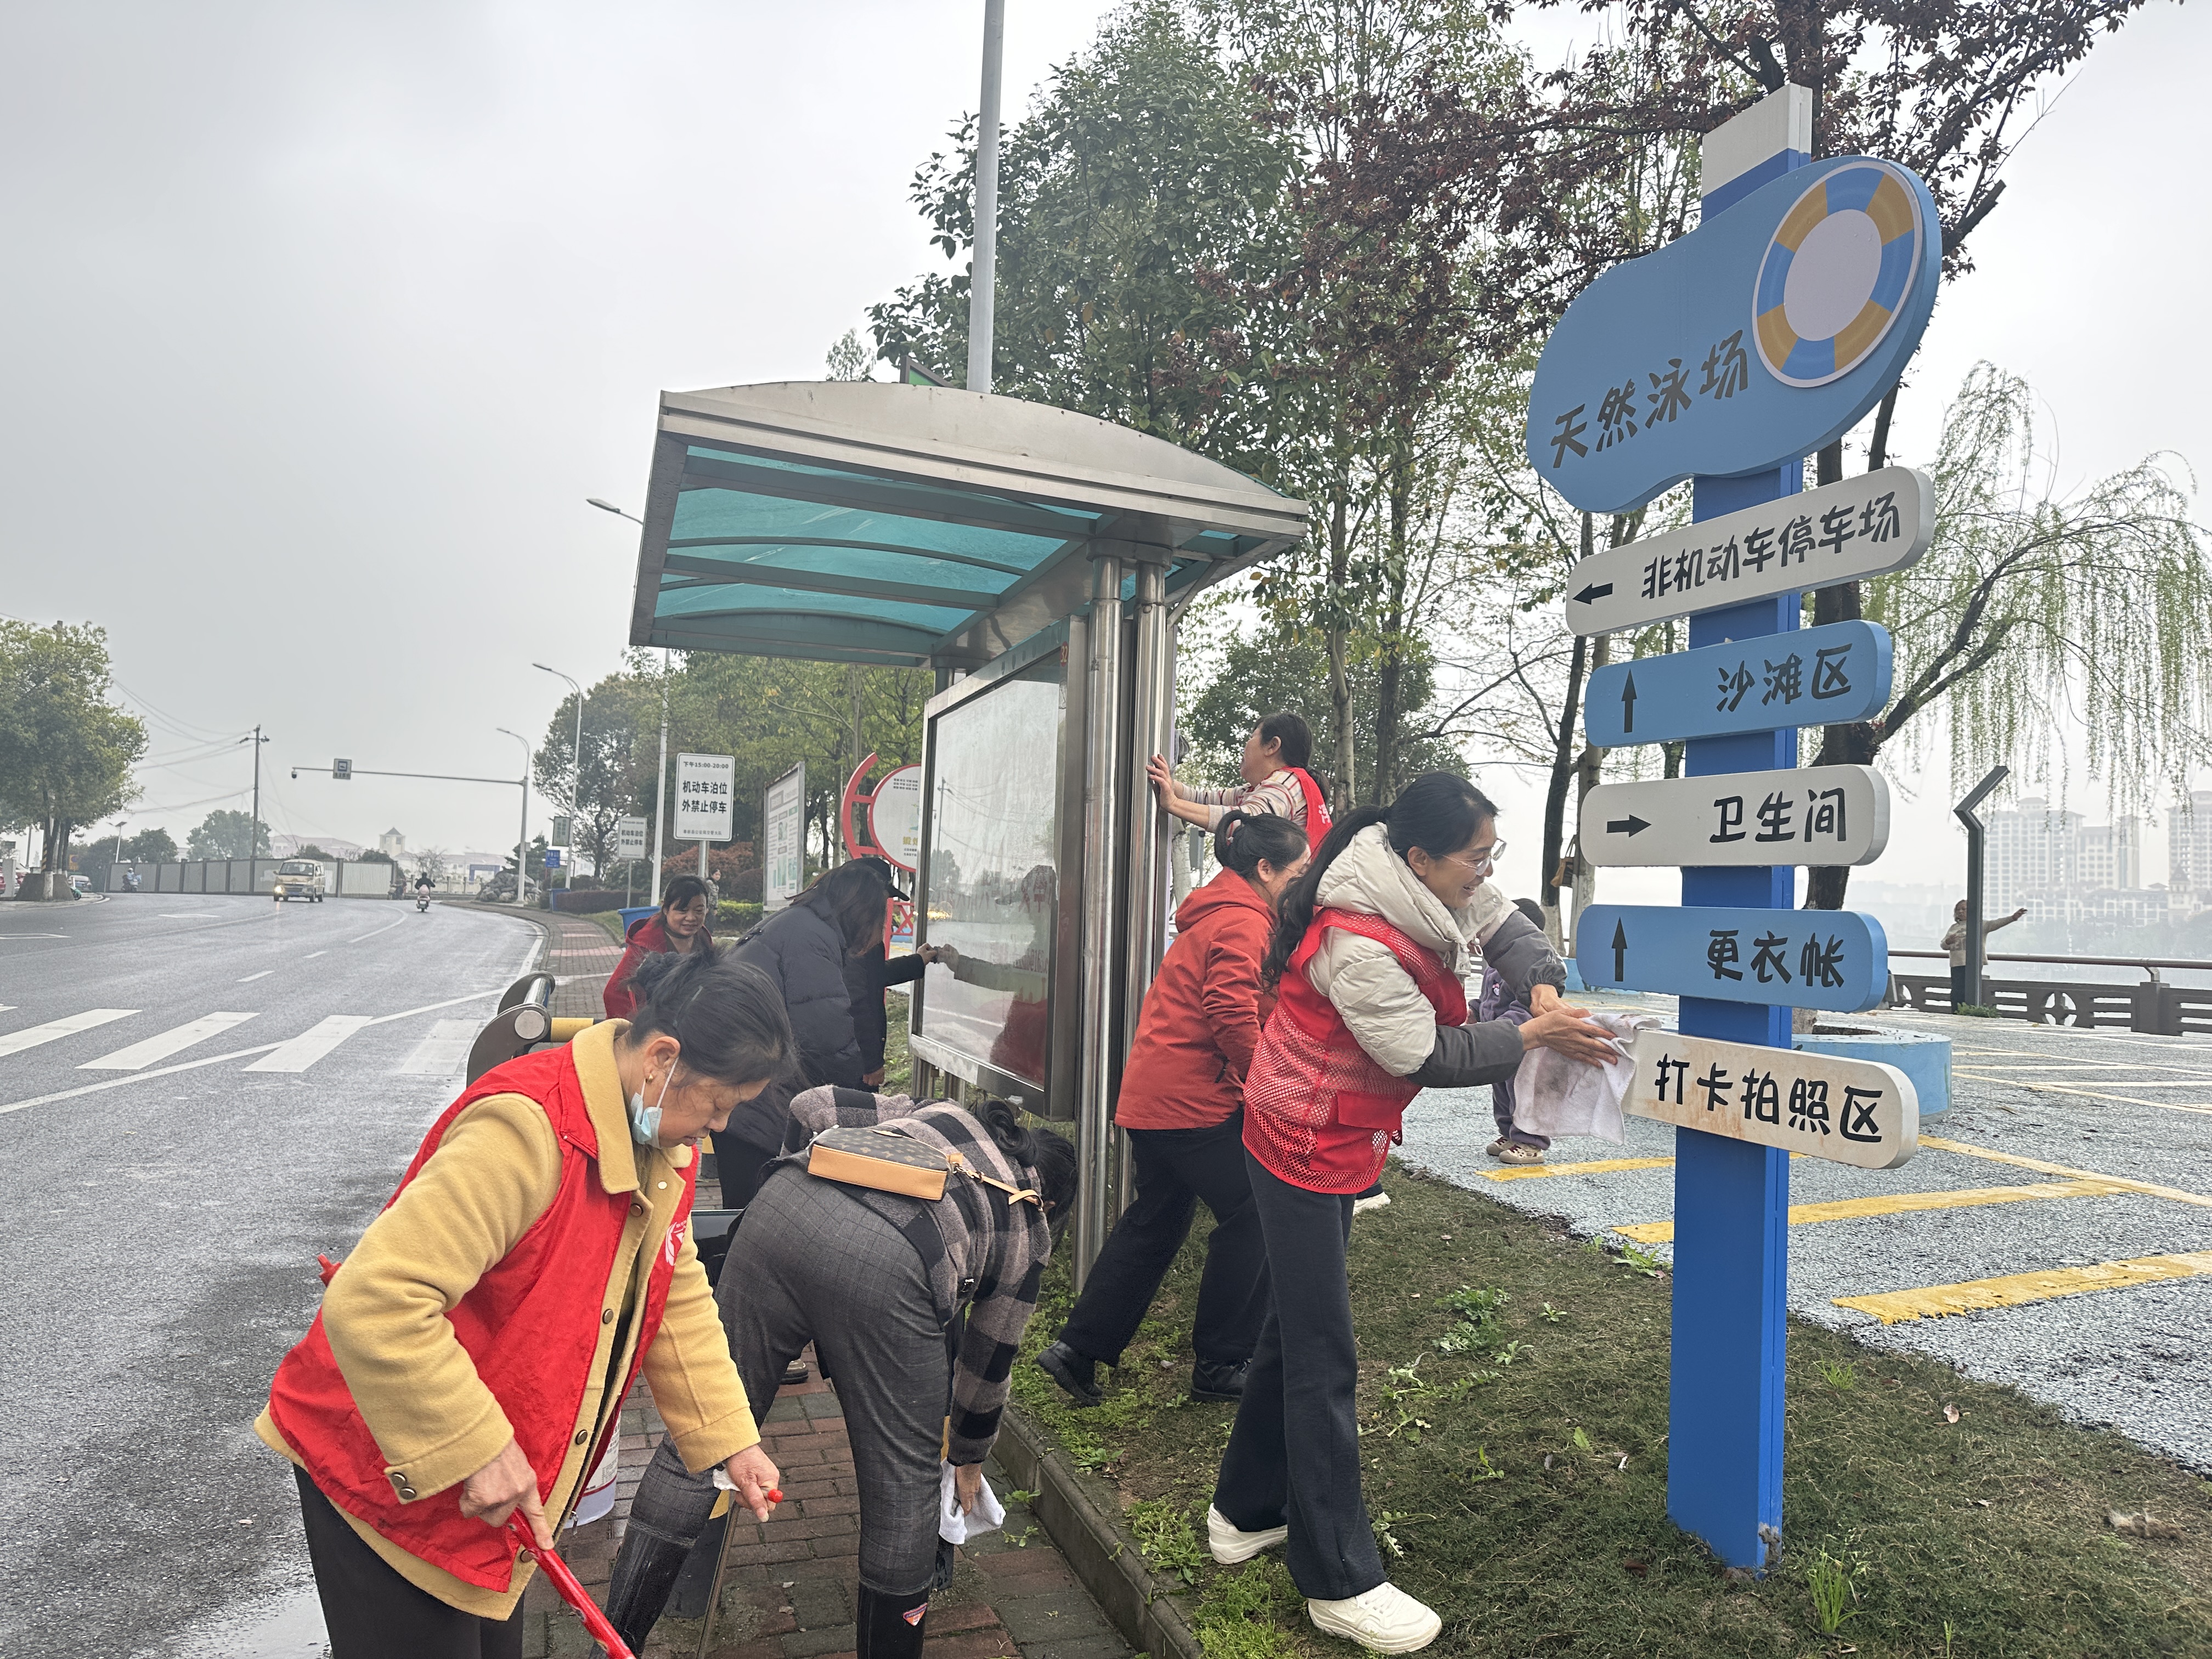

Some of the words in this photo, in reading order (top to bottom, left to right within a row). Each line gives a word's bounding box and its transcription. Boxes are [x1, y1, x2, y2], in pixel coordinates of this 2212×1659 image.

[1550, 330, 1748, 468] 天然泳场
[1641, 491, 1900, 599] 非机动车停车场
[1061, 646, 1068, 662] 32
[1716, 643, 1852, 712] 沙滩区
[682, 780, 727, 794] 机动车泊位
[682, 799, 727, 814] 外禁止停车
[1709, 787, 1847, 844] 卫生间
[1707, 929, 1844, 988] 更衣帐
[1655, 1053, 1882, 1143] 打卡拍照区
